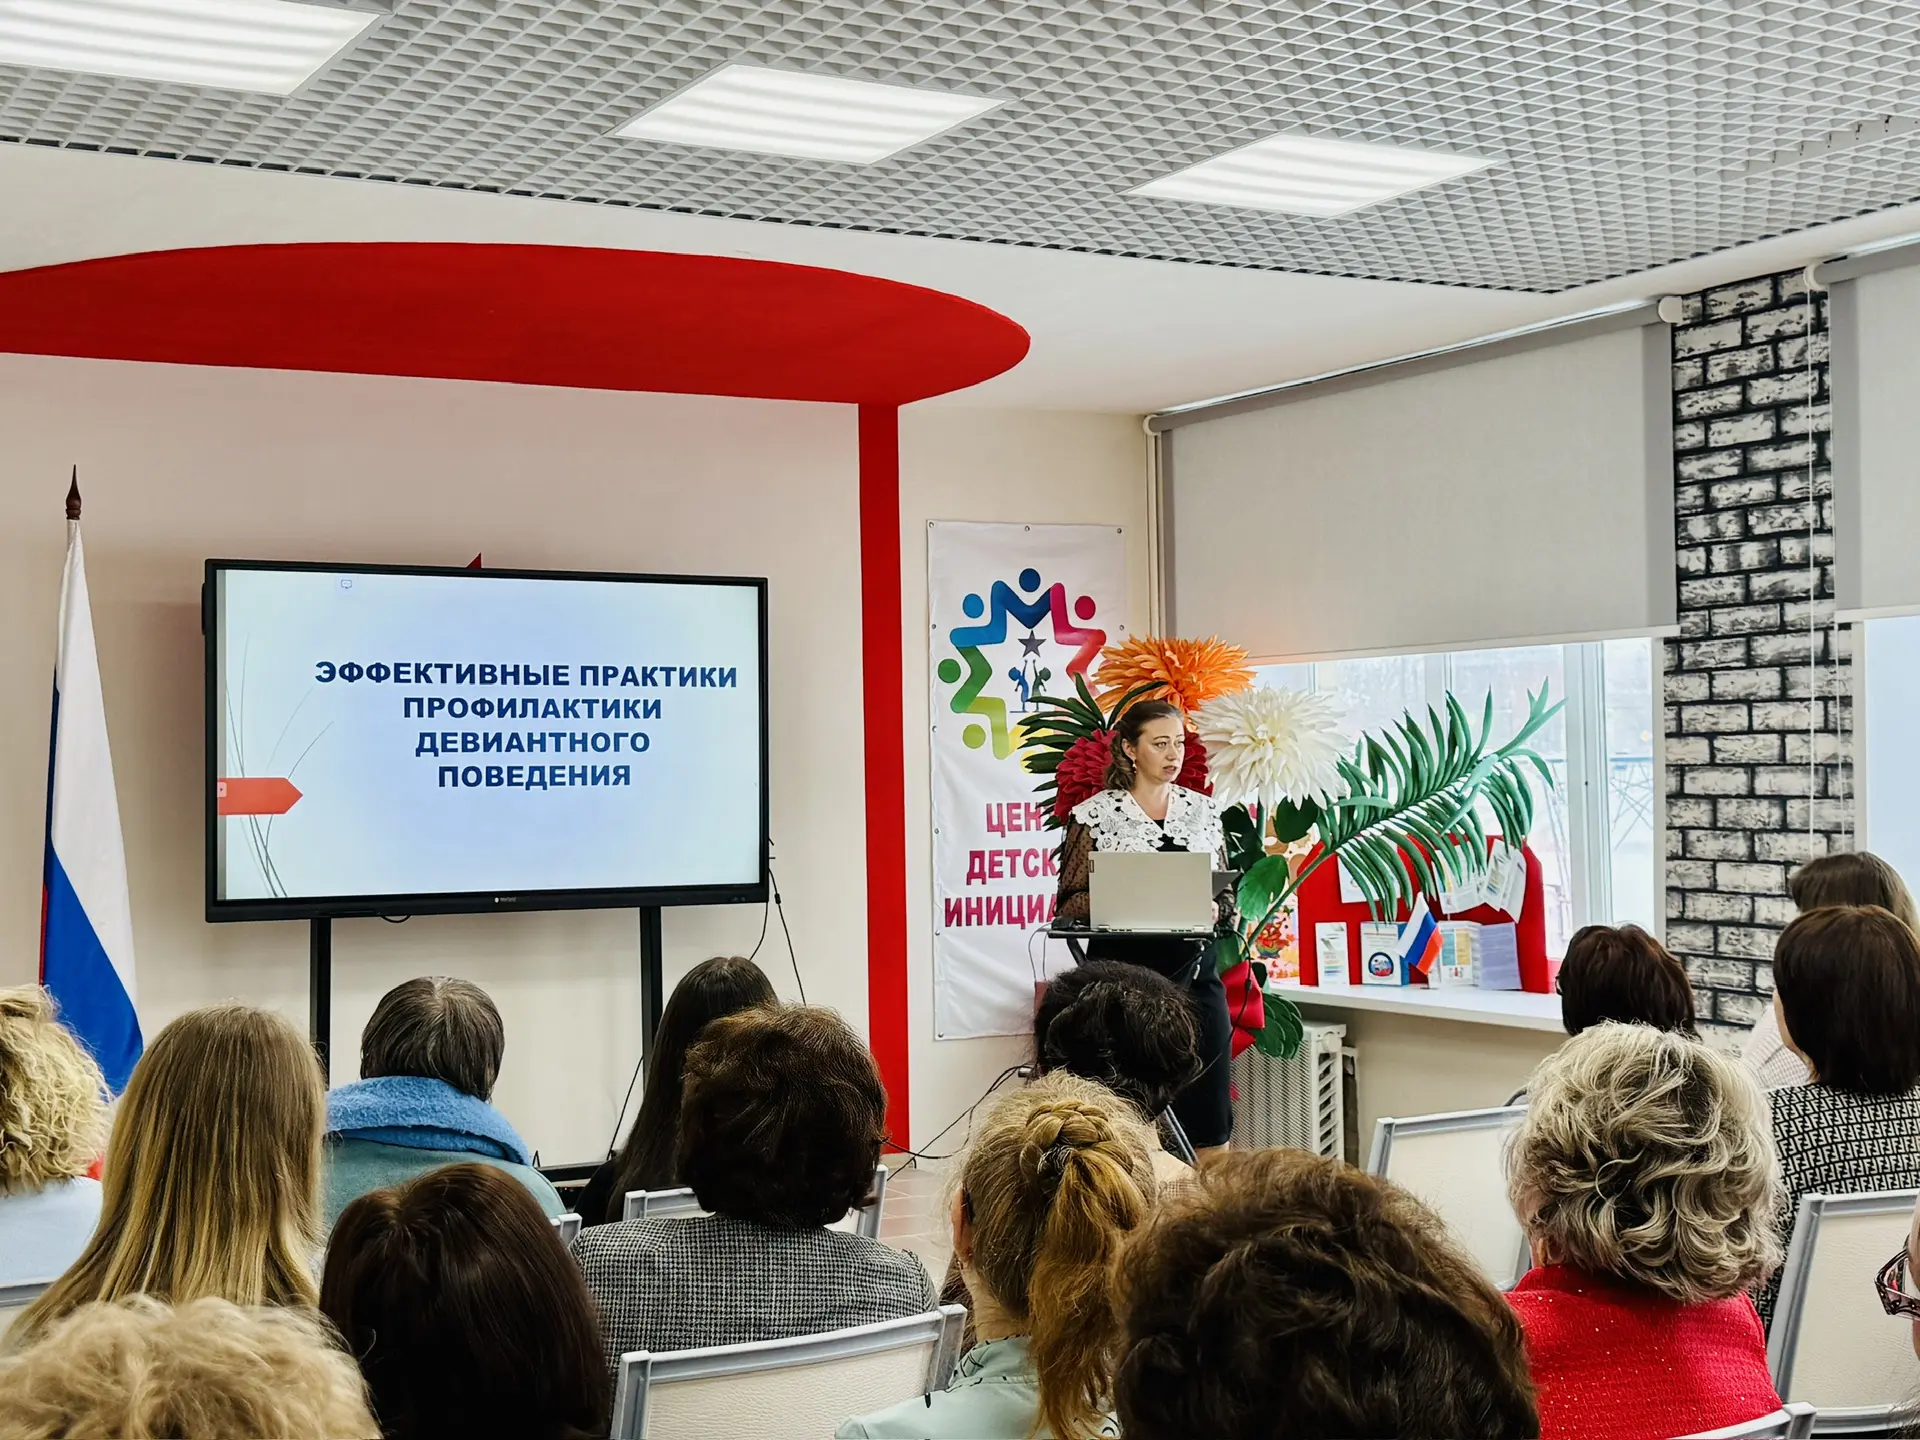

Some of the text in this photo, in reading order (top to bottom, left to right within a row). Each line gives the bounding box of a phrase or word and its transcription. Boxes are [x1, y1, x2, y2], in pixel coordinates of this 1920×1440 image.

[315, 661, 738, 688] ЭФФЕКТИВНЫЕ ПРАКТИКИ
[403, 696, 662, 720] ПРОФИЛАКТИКИ
[415, 731, 651, 757] ДЕВИАНТНОГО
[438, 765, 631, 791] ПОВЕДЕНИЯ
